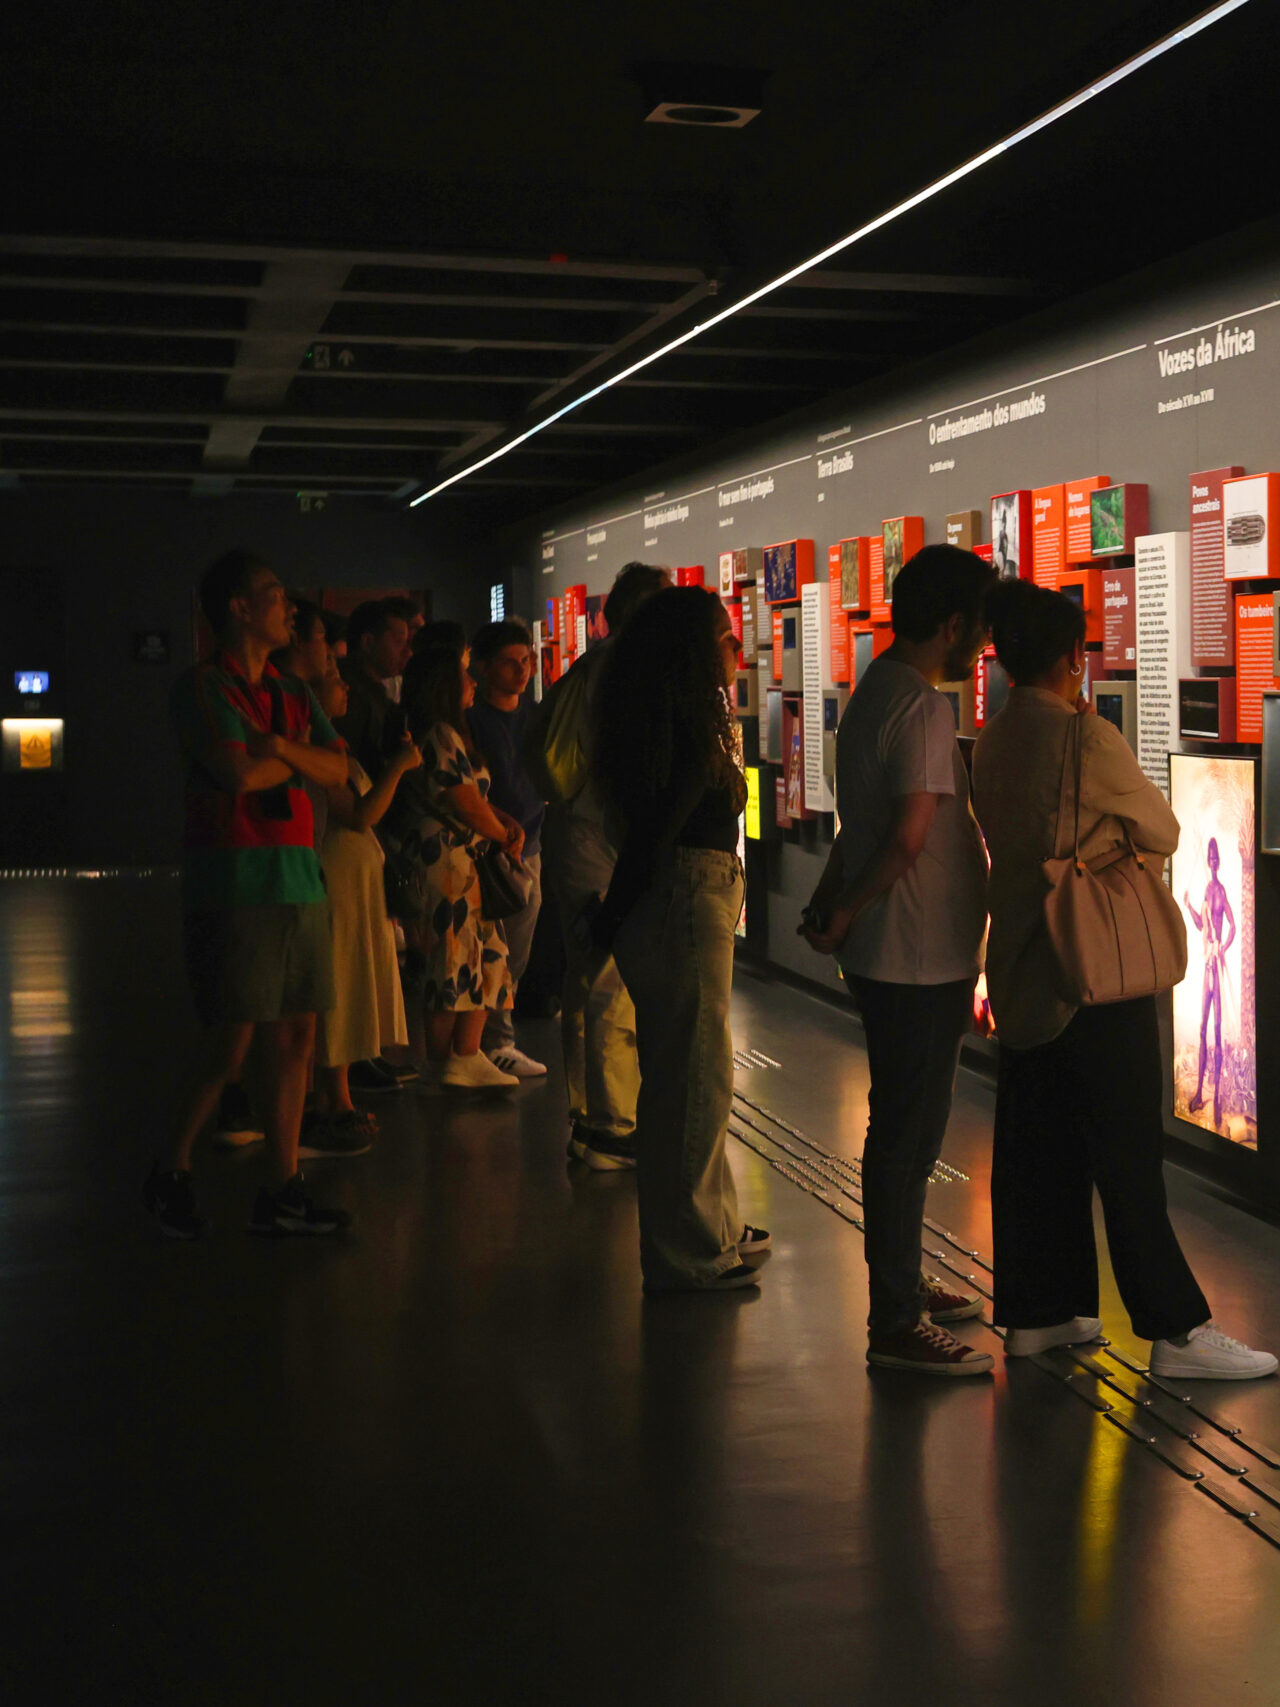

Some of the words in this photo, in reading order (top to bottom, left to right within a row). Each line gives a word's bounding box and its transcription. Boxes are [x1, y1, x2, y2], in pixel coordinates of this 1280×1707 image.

[1158, 348, 1196, 378] Vozes
[1196, 338, 1213, 367] da
[1214, 324, 1255, 362] África
[929, 422, 936, 445] O
[936, 408, 992, 443] enfrentamento
[993, 403, 1009, 427] dos
[1010, 391, 1045, 422] mundos
